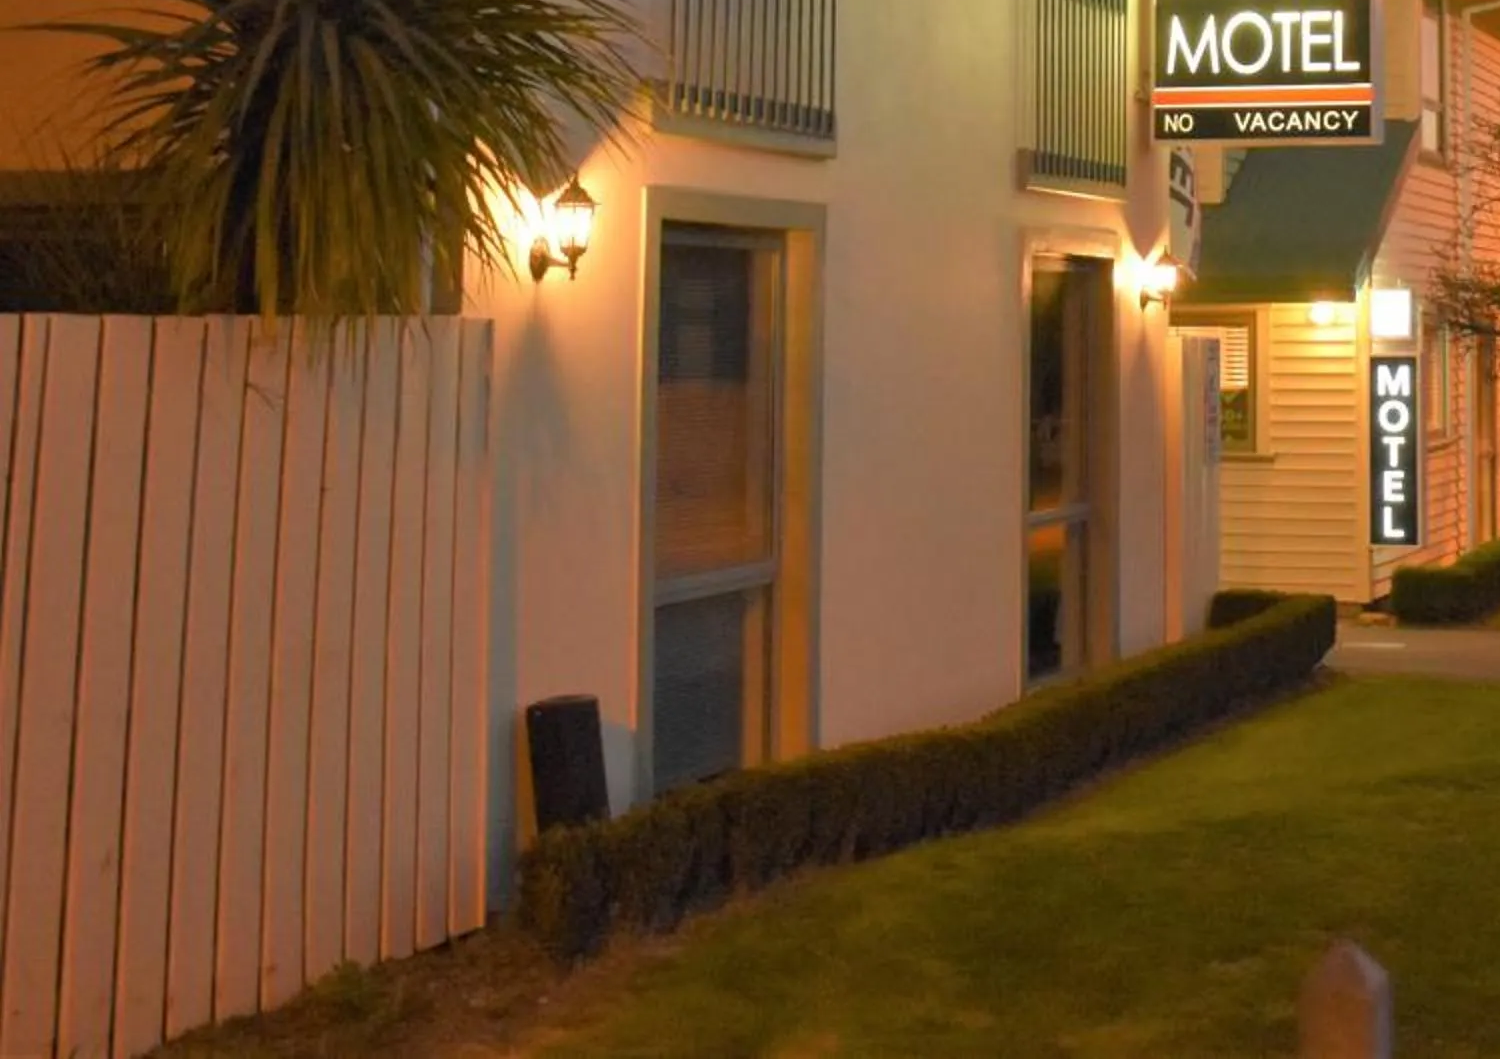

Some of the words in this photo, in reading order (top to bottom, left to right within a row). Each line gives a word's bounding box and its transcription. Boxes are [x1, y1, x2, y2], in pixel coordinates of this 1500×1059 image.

[1166, 10, 1361, 75] MOTEL
[1163, 113, 1195, 132] NO
[1233, 110, 1359, 132] VACANCY
[1376, 364, 1410, 538] MOTEL
